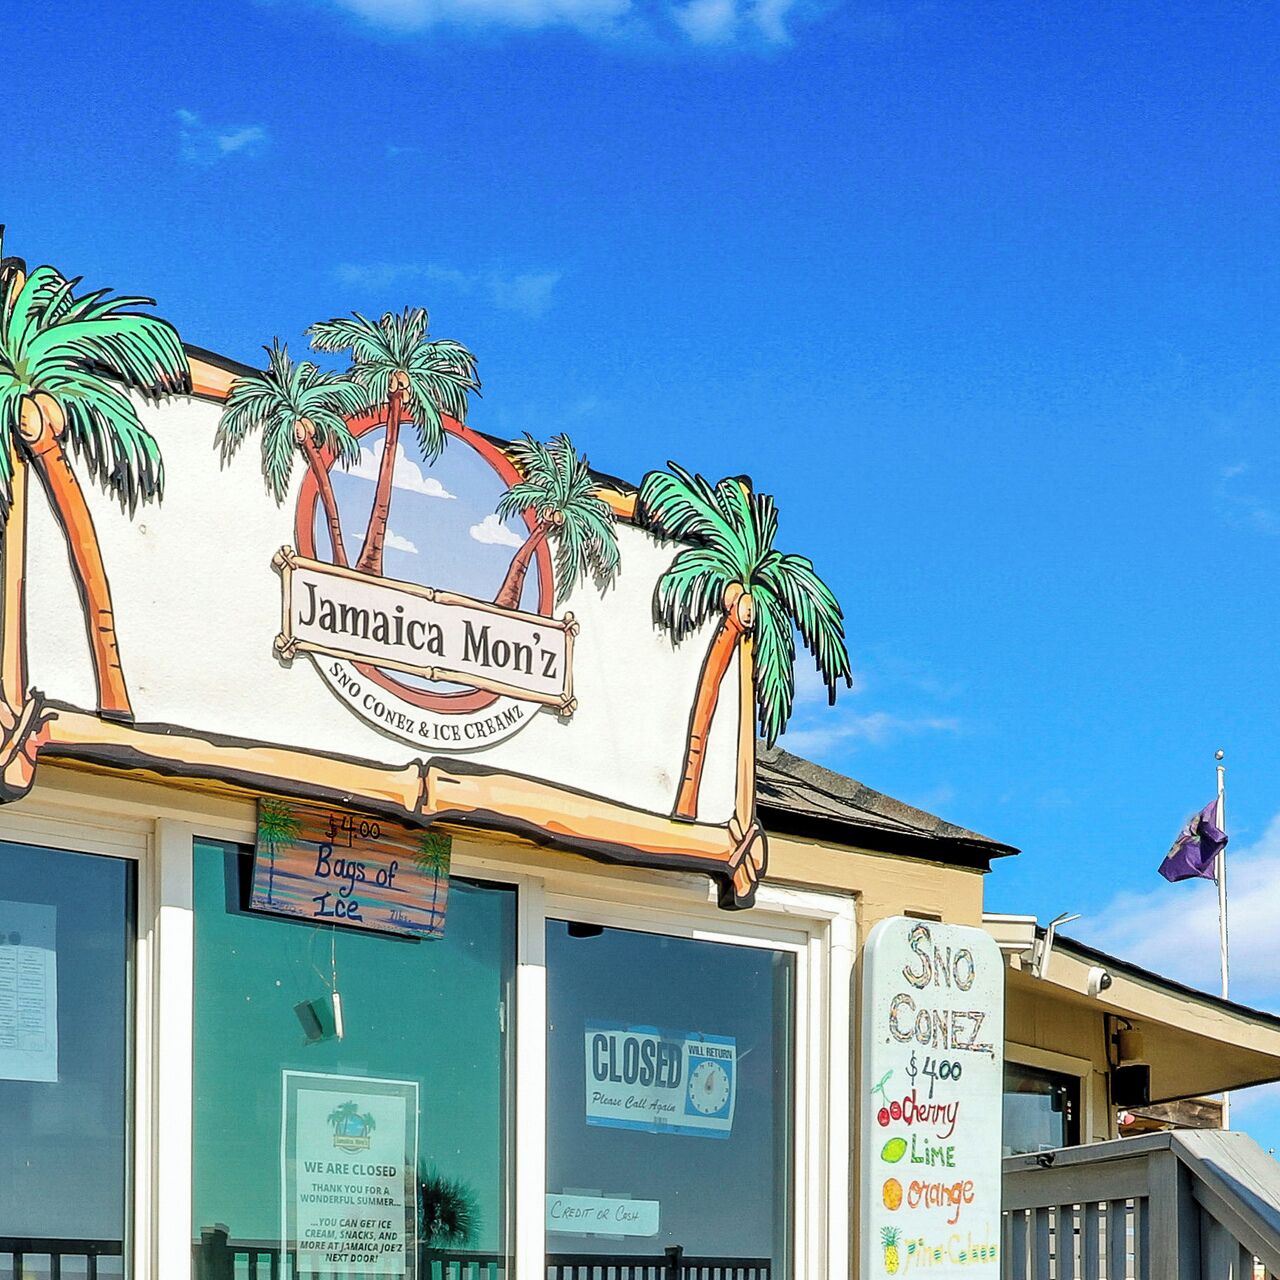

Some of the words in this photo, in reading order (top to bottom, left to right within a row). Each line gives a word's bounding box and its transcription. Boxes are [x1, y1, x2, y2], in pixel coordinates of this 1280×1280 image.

[299, 581, 445, 657] Jamaica
[462, 620, 557, 679] Mon'z
[329, 661, 362, 698] SNO
[363, 694, 415, 734] CONEZ
[418, 722, 430, 737] &
[434, 724, 461, 741] ICE
[464, 704, 525, 740] CREAMZ
[325, 813, 380, 848] $4.00
[315, 844, 366, 898] Bags
[376, 861, 399, 888] of
[313, 891, 364, 922] Ice
[902, 923, 976, 992] SNO
[889, 992, 995, 1054] CONEZ
[592, 1033, 683, 1090] CLOSED
[688, 1045, 704, 1056] WILL
[706, 1047, 733, 1060] RETURN
[905, 1050, 962, 1099] $4.00
[592, 1091, 622, 1107] Please
[625, 1095, 648, 1109] Call
[648, 1099, 676, 1114] Again
[902, 1089, 960, 1140] Cherry
[304, 1161, 324, 1173] WE
[326, 1162, 349, 1175] ARE
[352, 1164, 397, 1177] CLOSED
[300, 1194, 355, 1204] WONDERFUL
[312, 1183, 343, 1193] THANK
[344, 1184, 363, 1194] YOU
[365, 1186, 381, 1195] FOR
[383, 1187, 390, 1196] A
[305, 1228, 337, 1240] CREAM,
[340, 1230, 376, 1241] SNACKS,
[378, 1232, 398, 1241] AND
[339, 1218, 358, 1228] CAN
[359, 1220, 376, 1229] GET
[378, 1220, 392, 1229] ICE
[300, 1241, 326, 1250] MORE
[327, 1242, 340, 1250] AT
[340, 1242, 379, 1252] JAMAICA
[380, 1243, 403, 1254] JOE'Z
[325, 1253, 348, 1263] NEXT
[350, 1254, 379, 1263] DOOR!
